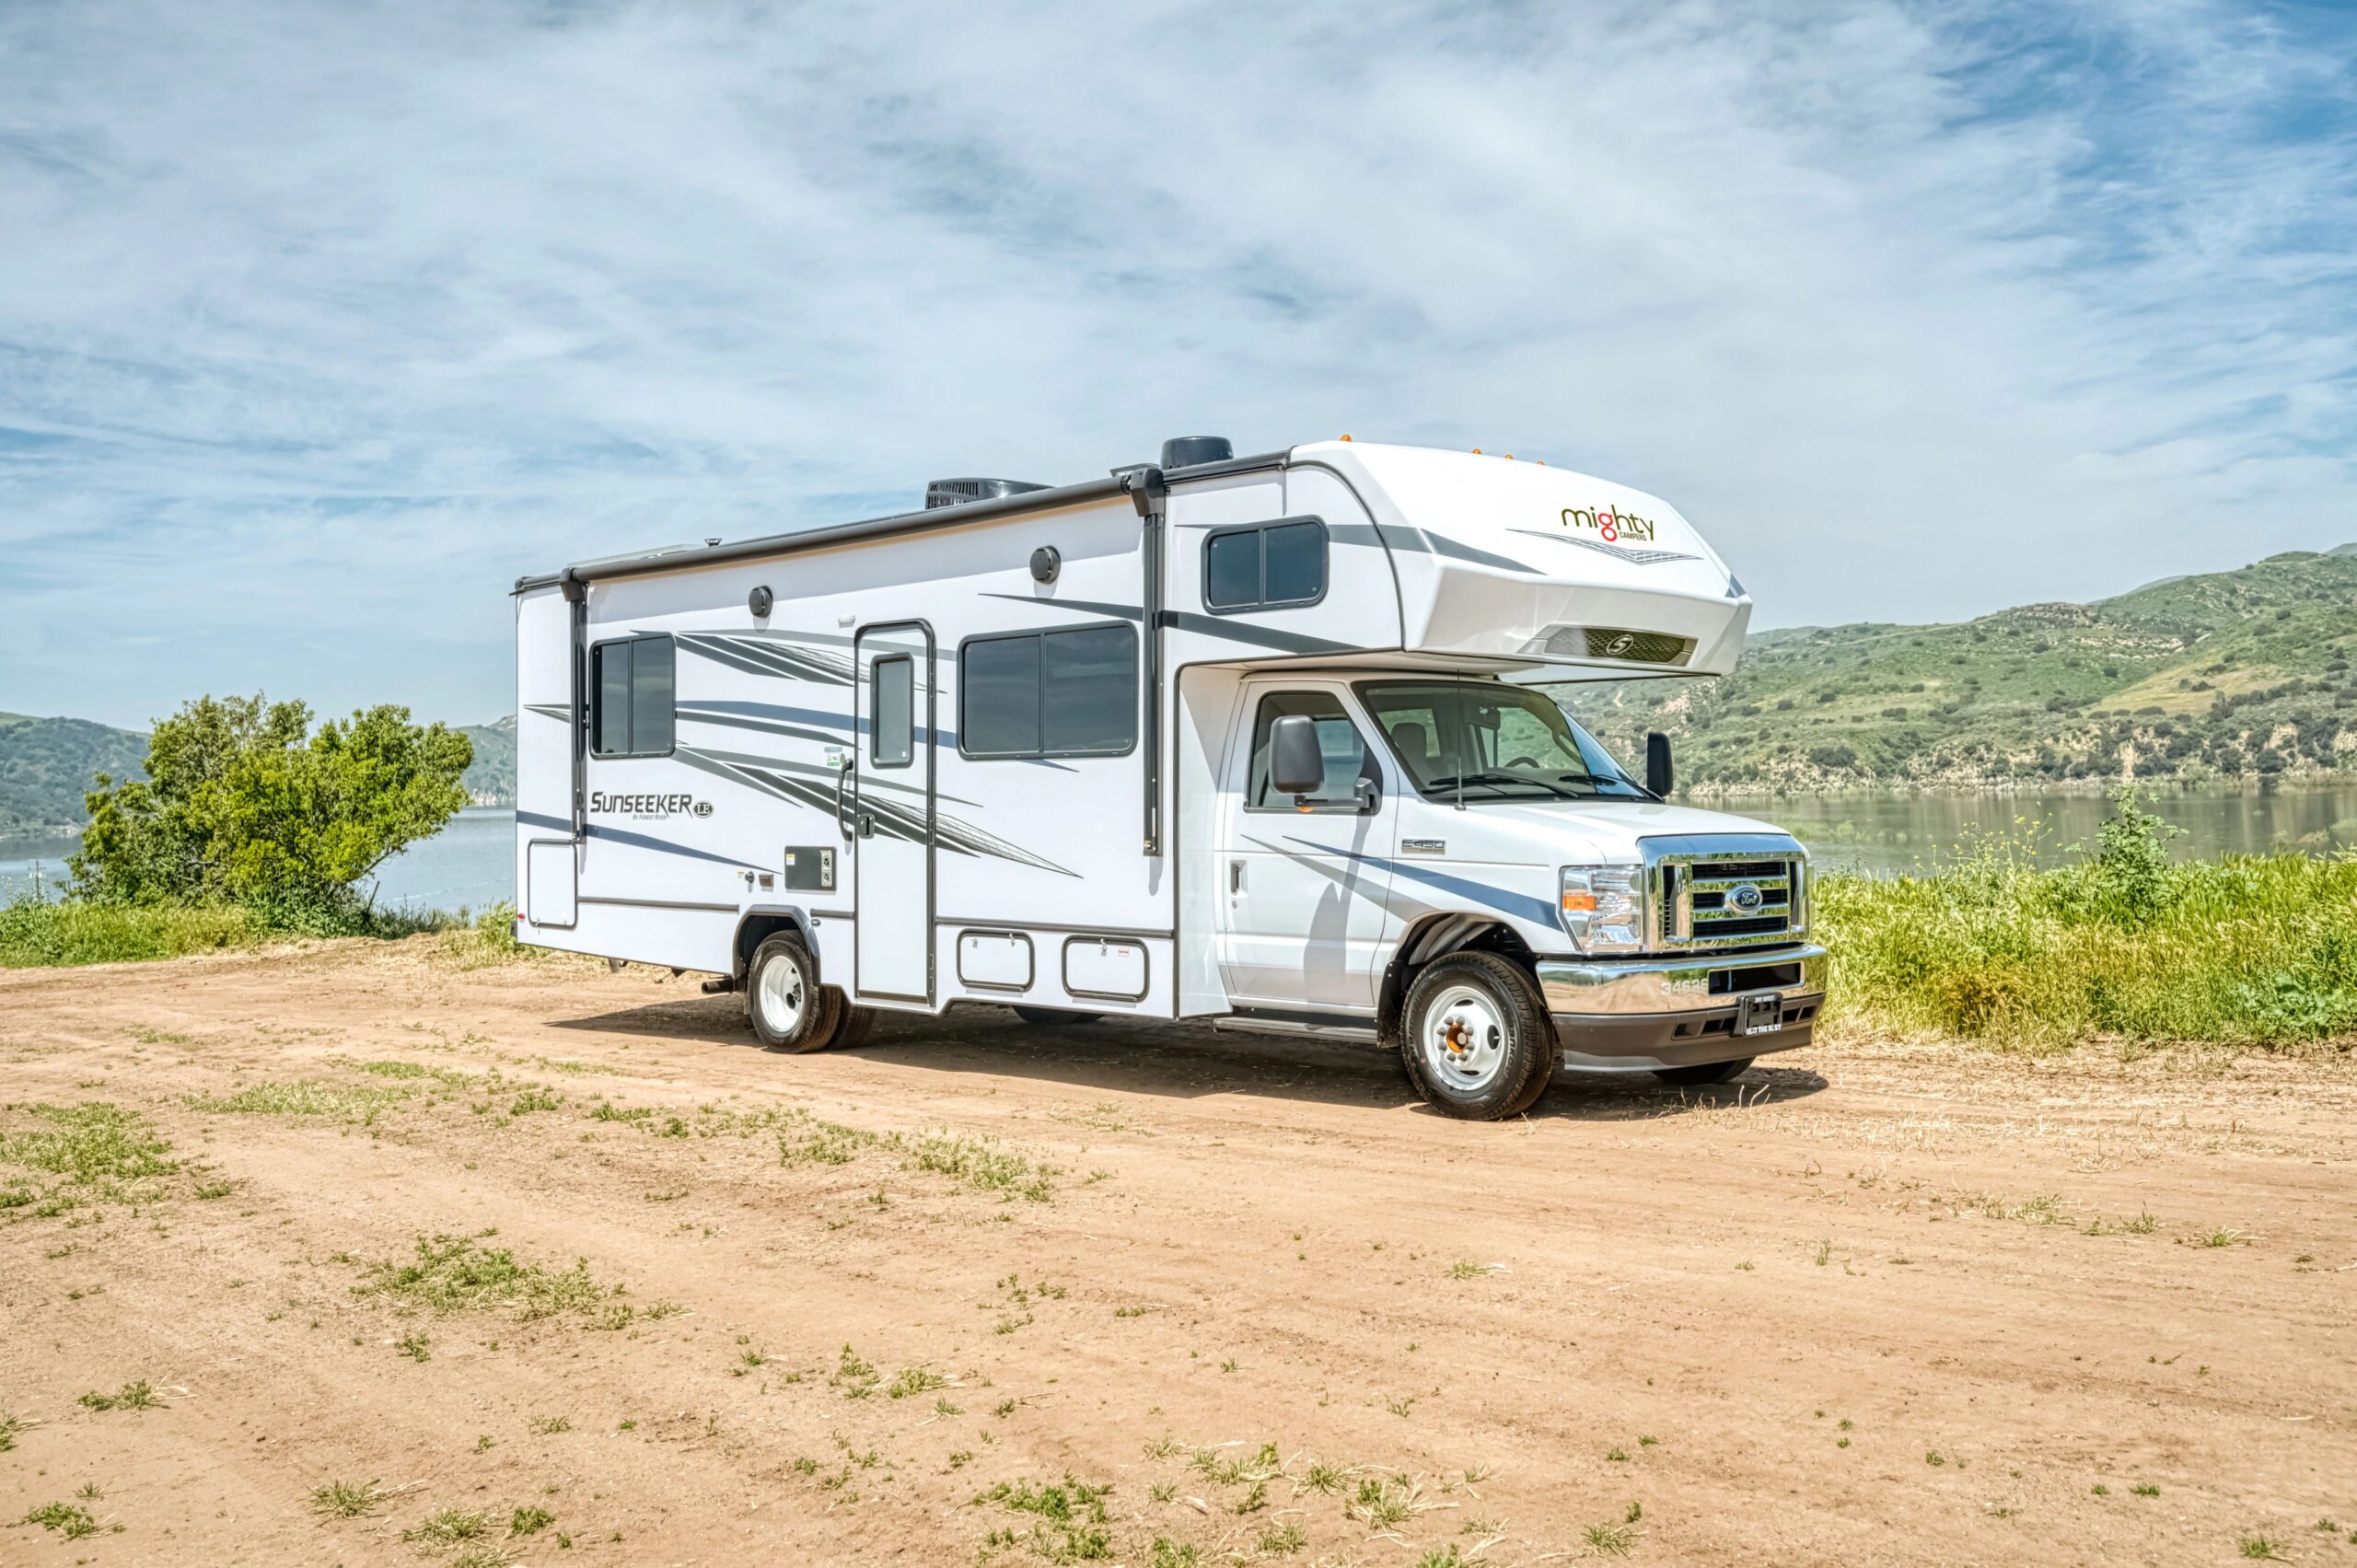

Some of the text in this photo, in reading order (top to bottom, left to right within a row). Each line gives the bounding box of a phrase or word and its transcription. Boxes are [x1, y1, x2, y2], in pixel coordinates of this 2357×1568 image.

[1562, 505, 1654, 541] mighty
[1619, 531, 1647, 541] CAMPERS
[697, 804, 711, 814] LE
[1741, 892, 1758, 904] Ford
